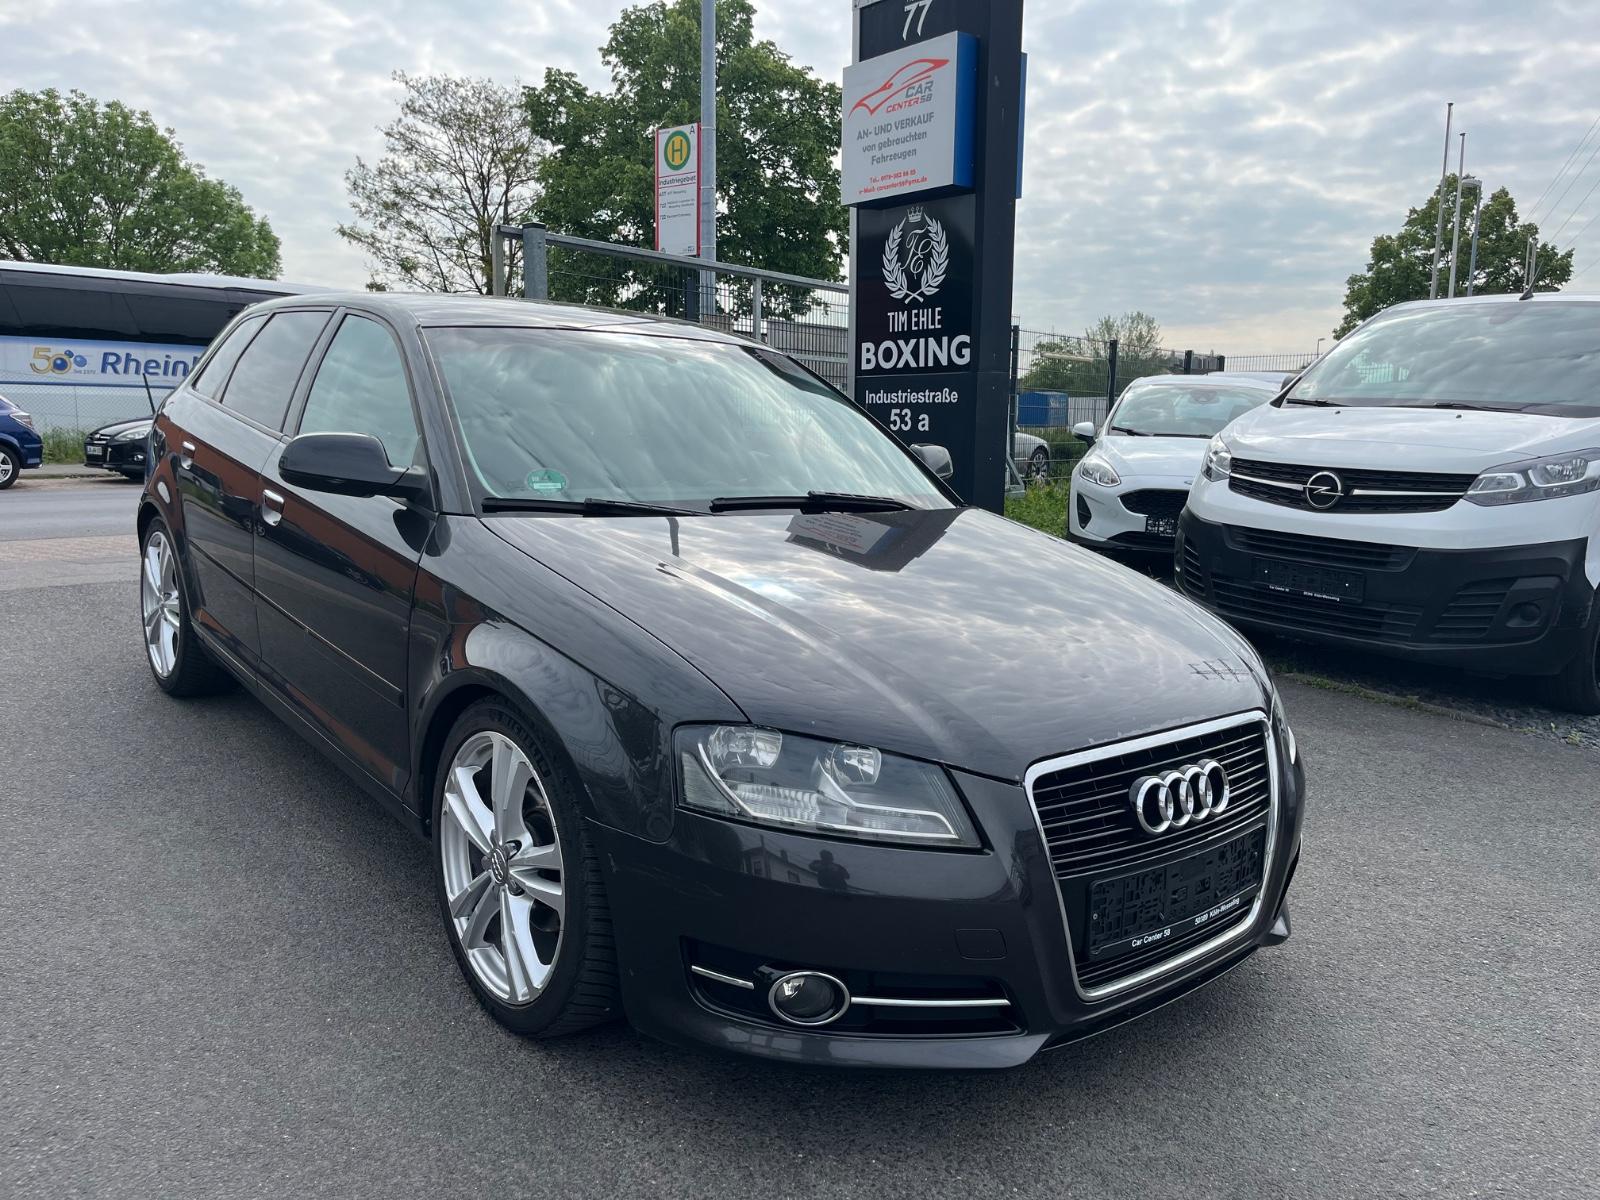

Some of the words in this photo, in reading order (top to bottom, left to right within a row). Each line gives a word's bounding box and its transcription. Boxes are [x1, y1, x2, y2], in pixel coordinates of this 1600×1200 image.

[902, 0, 933, 41] 77
[905, 80, 934, 98] CAR
[689, 125, 696, 135] A
[857, 128, 873, 141] AN-
[874, 122, 893, 136] UND
[894, 111, 935, 131] VERKAUF
[671, 138, 683, 163] H
[862, 143, 876, 153] von
[877, 131, 927, 152] gebrauchten
[871, 148, 917, 166] Fahrzeugen
[887, 310, 908, 333] TIM
[911, 307, 942, 331] EHLE
[861, 334, 971, 371] BOXING
[865, 387, 959, 404] Industriestraße
[889, 408, 912, 431] 53
[917, 413, 930, 432] a
[1131, 938, 1143, 948] Car
[1143, 931, 1164, 944] Center
